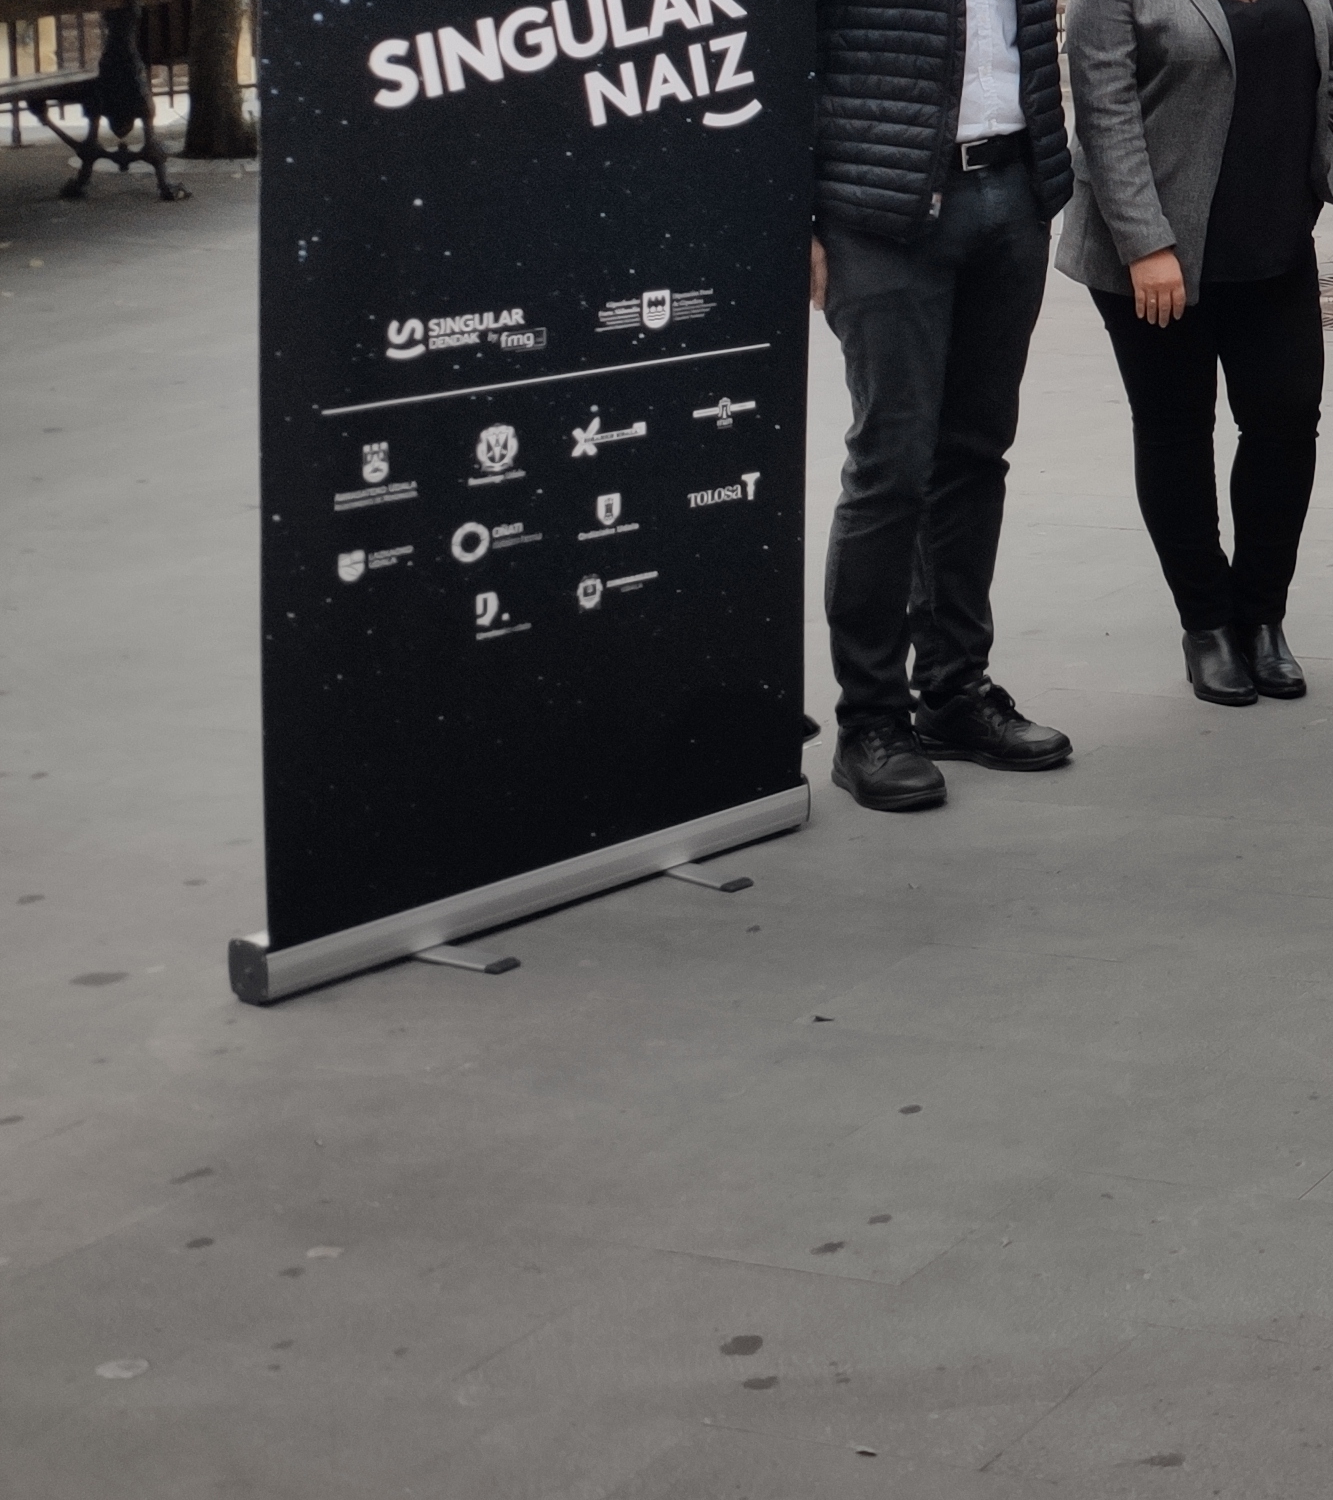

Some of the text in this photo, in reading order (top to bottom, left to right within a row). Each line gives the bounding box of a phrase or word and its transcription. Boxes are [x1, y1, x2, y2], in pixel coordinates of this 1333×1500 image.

[584, 31, 754, 128] NAIZ
[428, 308, 525, 336] SINGULAR
[428, 332, 480, 349] DENDAK
[500, 332, 535, 349] fmg
